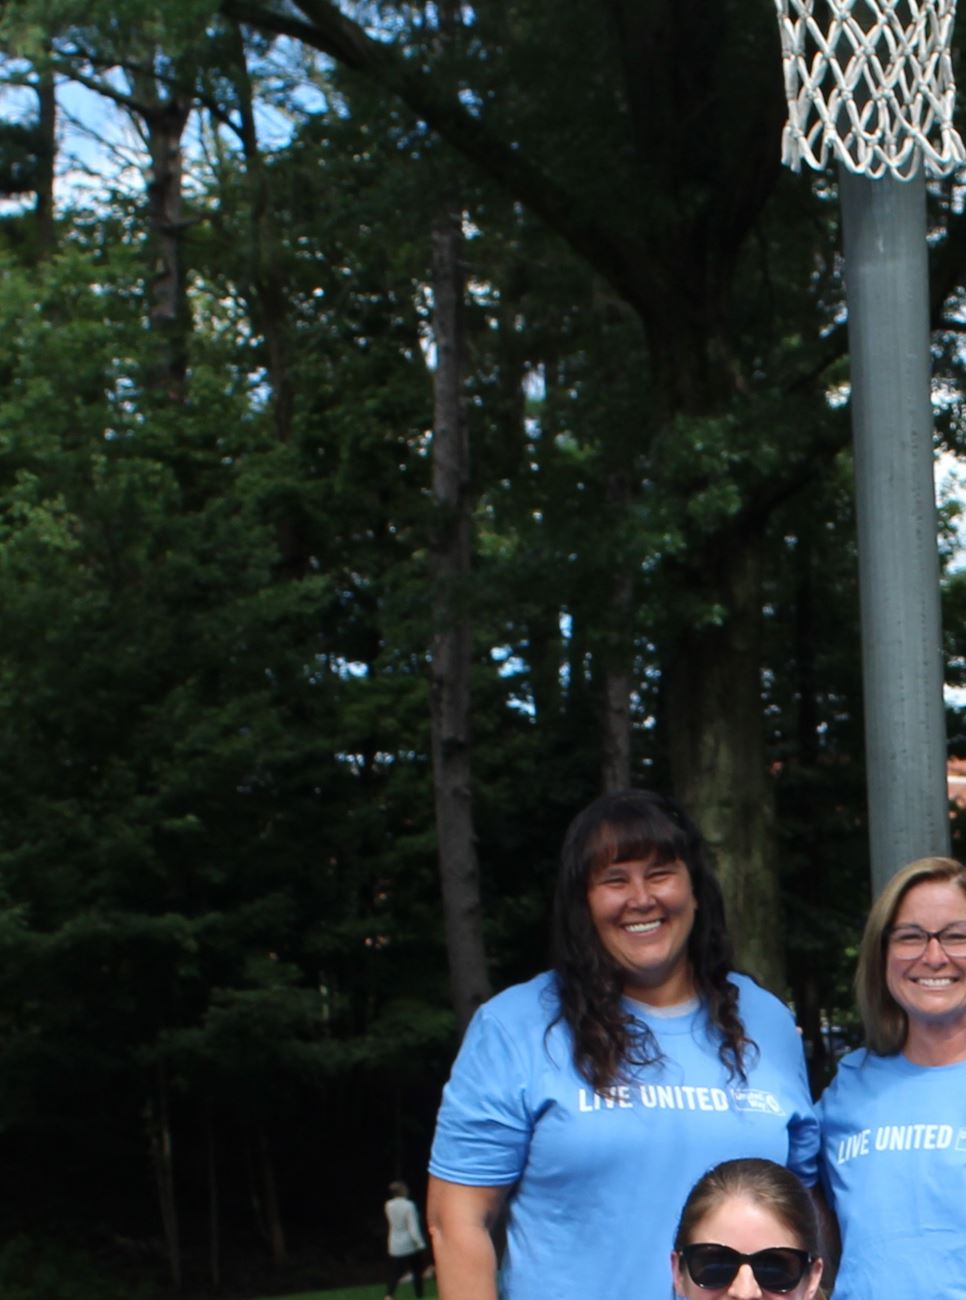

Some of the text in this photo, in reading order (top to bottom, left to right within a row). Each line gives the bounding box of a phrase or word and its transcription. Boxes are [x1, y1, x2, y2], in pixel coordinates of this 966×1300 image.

[579, 1086, 633, 1112] LIVE
[640, 1085, 729, 1111] UNITED
[838, 1124, 953, 1164] LIVE UNITED
